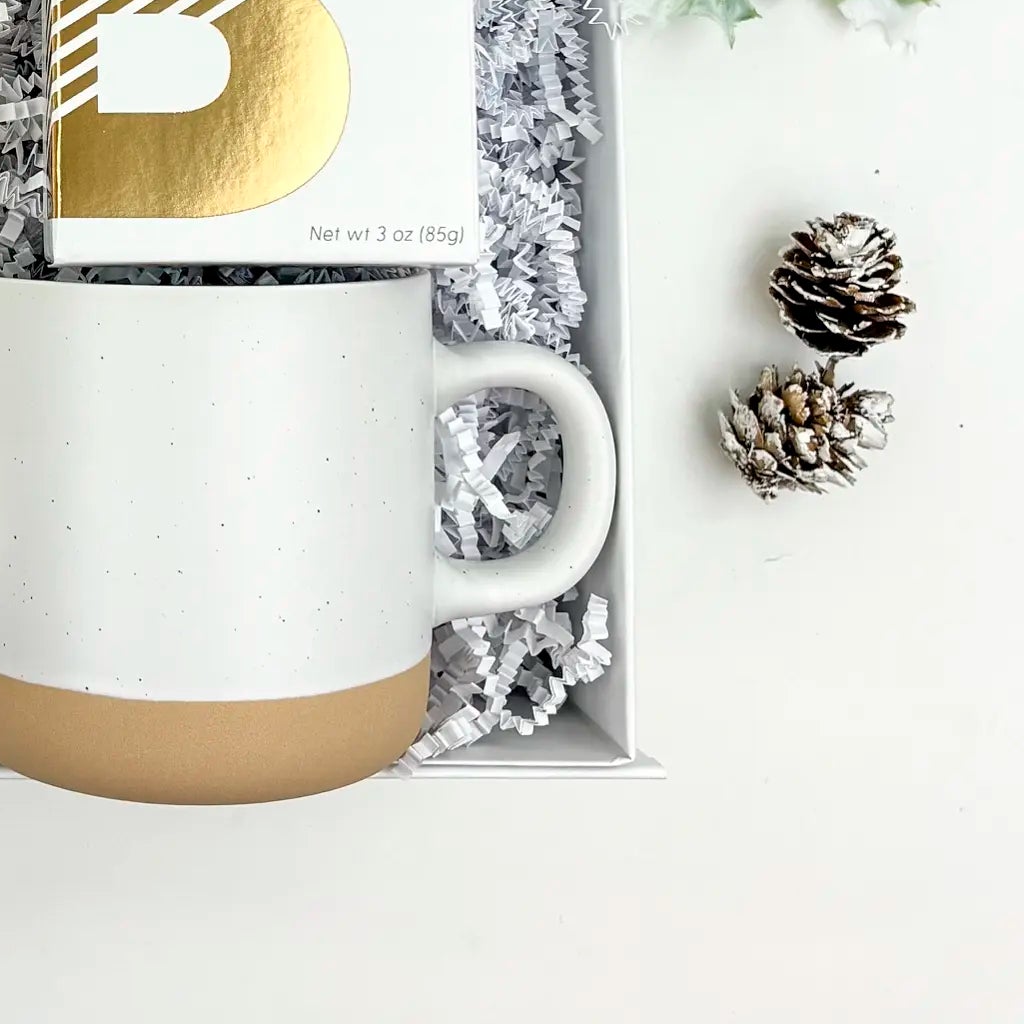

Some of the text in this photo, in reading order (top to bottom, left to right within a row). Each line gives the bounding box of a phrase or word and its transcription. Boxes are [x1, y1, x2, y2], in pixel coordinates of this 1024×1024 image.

[309, 225, 465, 246] Net wt 3 oz (85g)
